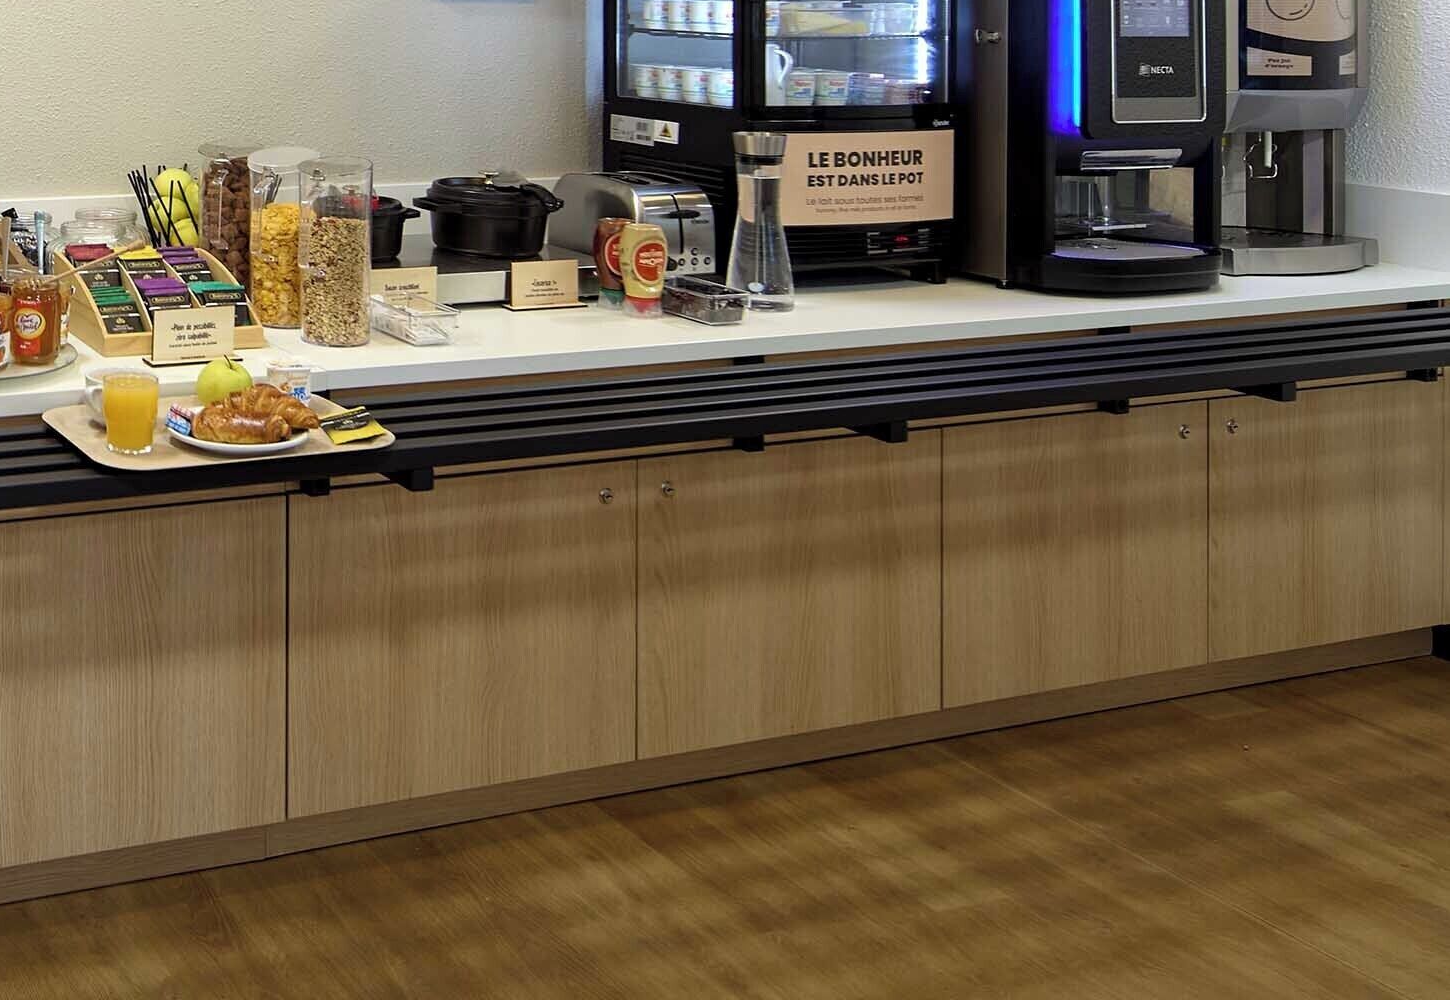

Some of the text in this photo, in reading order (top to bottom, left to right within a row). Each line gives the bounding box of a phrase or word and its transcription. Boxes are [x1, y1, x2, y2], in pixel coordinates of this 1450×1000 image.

[1150, 66, 1175, 74] NECTA
[807, 149, 923, 168] LE BONHEUR
[807, 171, 924, 187] EST DANS LE POT
